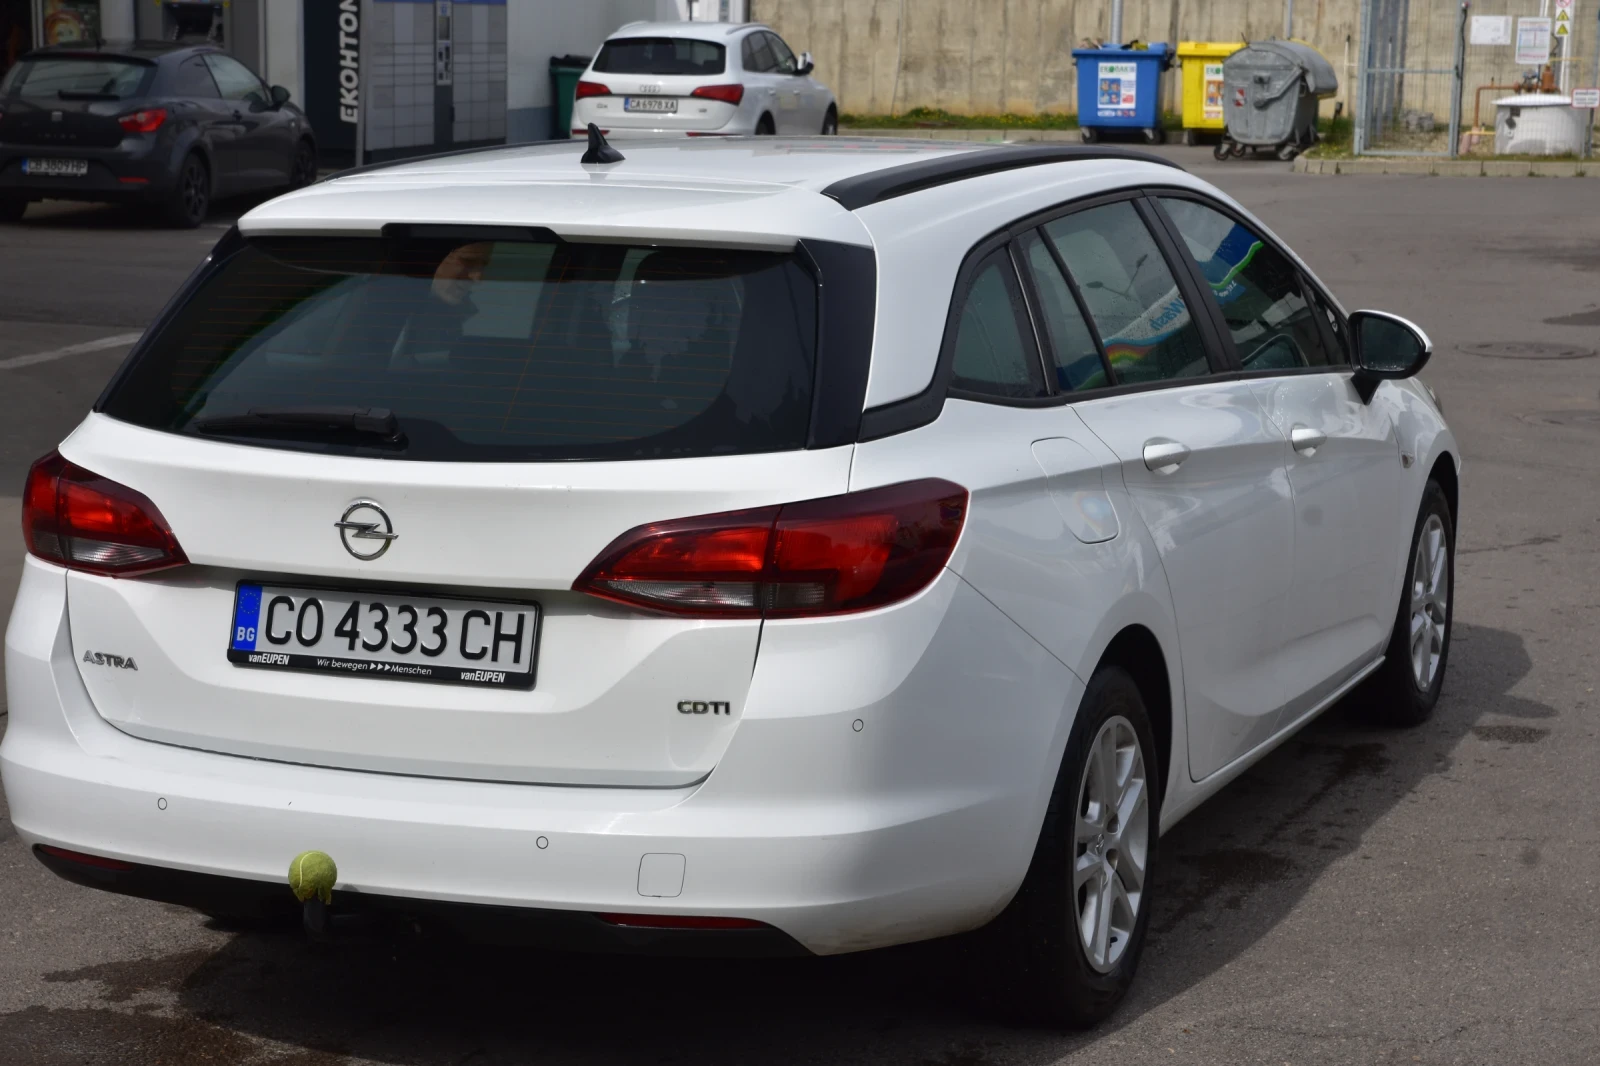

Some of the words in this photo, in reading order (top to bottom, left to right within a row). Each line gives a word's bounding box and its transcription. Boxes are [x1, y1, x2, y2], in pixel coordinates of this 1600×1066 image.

[236, 626, 256, 642] BG
[265, 595, 324, 647] CO
[334, 600, 448, 657] 4333
[459, 609, 525, 664] CH
[83, 650, 138, 671] ASTRA
[248, 653, 290, 665] vanEUPEN
[317, 658, 330, 667] Wir
[331, 659, 368, 671] bewegen
[390, 664, 432, 675] Menschen
[460, 671, 506, 683] vanEUPEN
[677, 701, 730, 715] CDTI
